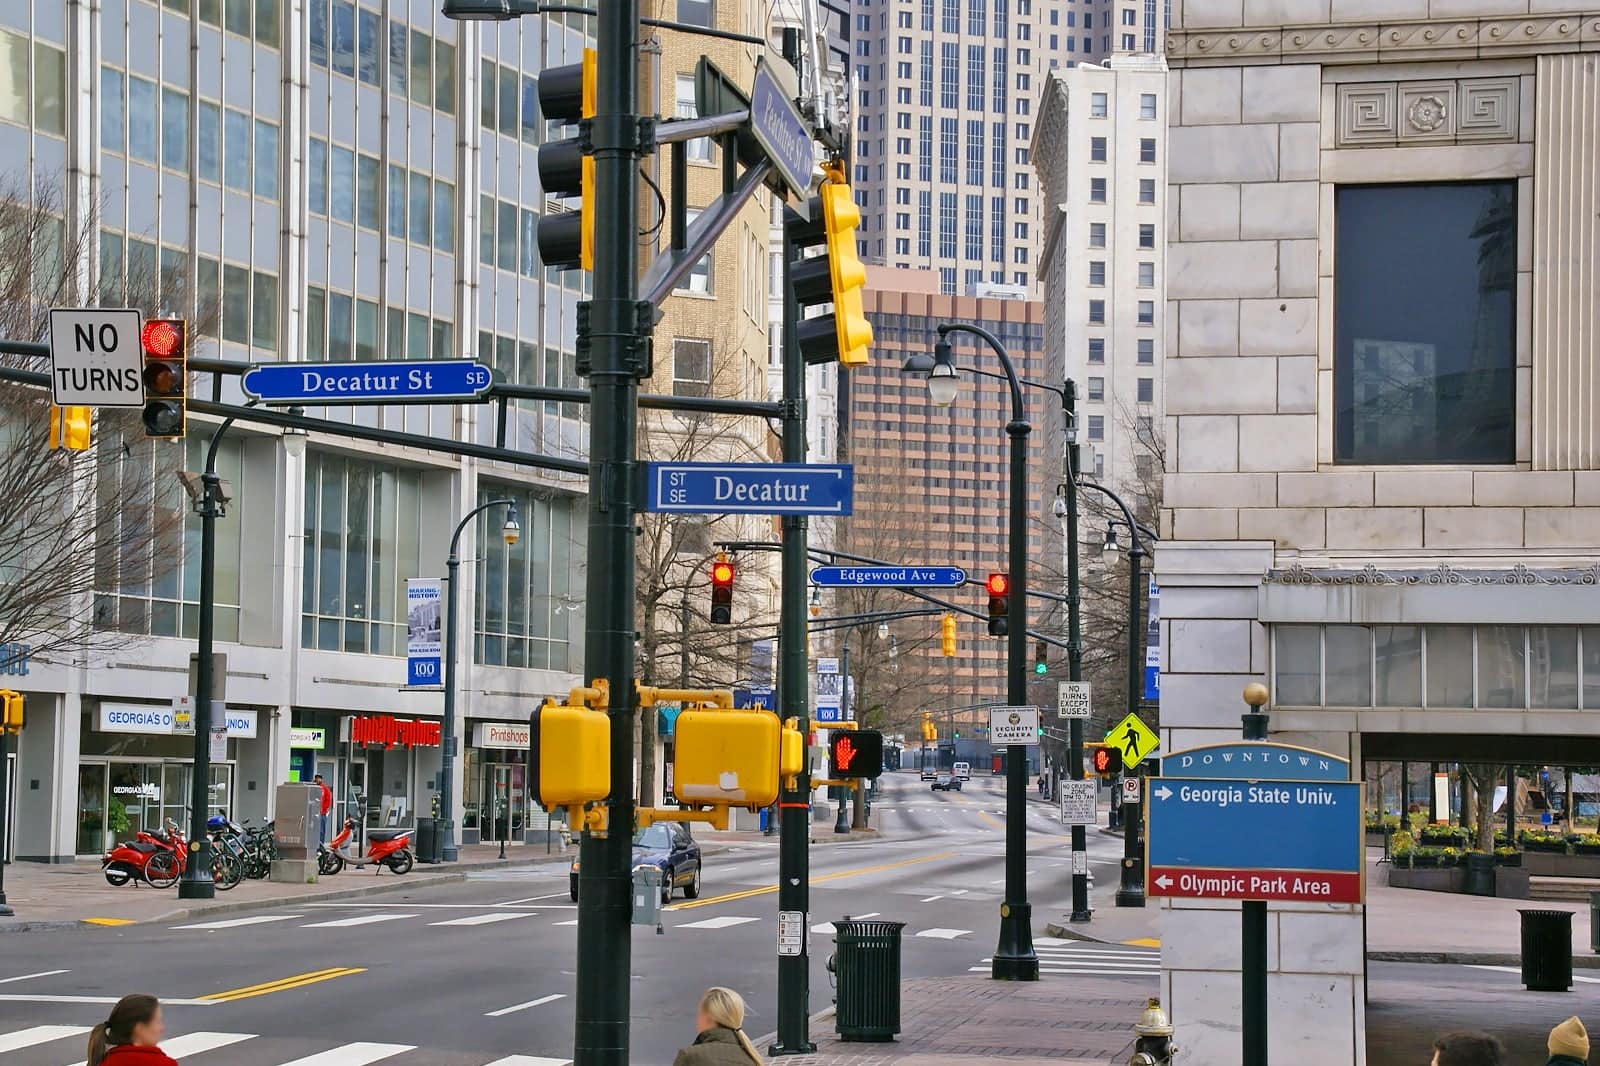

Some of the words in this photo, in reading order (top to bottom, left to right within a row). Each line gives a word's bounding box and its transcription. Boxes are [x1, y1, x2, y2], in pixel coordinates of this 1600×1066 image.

[763, 91, 795, 162] Peachtree
[75, 323, 118, 353] NO
[57, 368, 139, 392] TURNS
[301, 371, 400, 392] Decatur
[408, 369, 433, 390] St
[466, 372, 485, 385] SE
[670, 472, 687, 487] ST
[713, 475, 810, 502] Decatur
[670, 489, 687, 504] SE
[840, 569, 906, 583] Edgewood
[911, 569, 936, 580] Ave
[950, 573, 962, 581] SE
[415, 663, 435, 675] 100
[108, 711, 161, 725] GEORGIA'S
[225, 719, 249, 729] UNION
[821, 711, 835, 720] 100
[490, 727, 529, 744] Printshops
[1181, 753, 1329, 770] DOWNTOWN
[1180, 786, 1243, 807] Georgia
[1248, 787, 1290, 804] State
[1296, 788, 1337, 805] Univ.
[1180, 875, 1245, 895] Olympic
[1250, 877, 1286, 894] Park
[1292, 878, 1331, 894] Area
